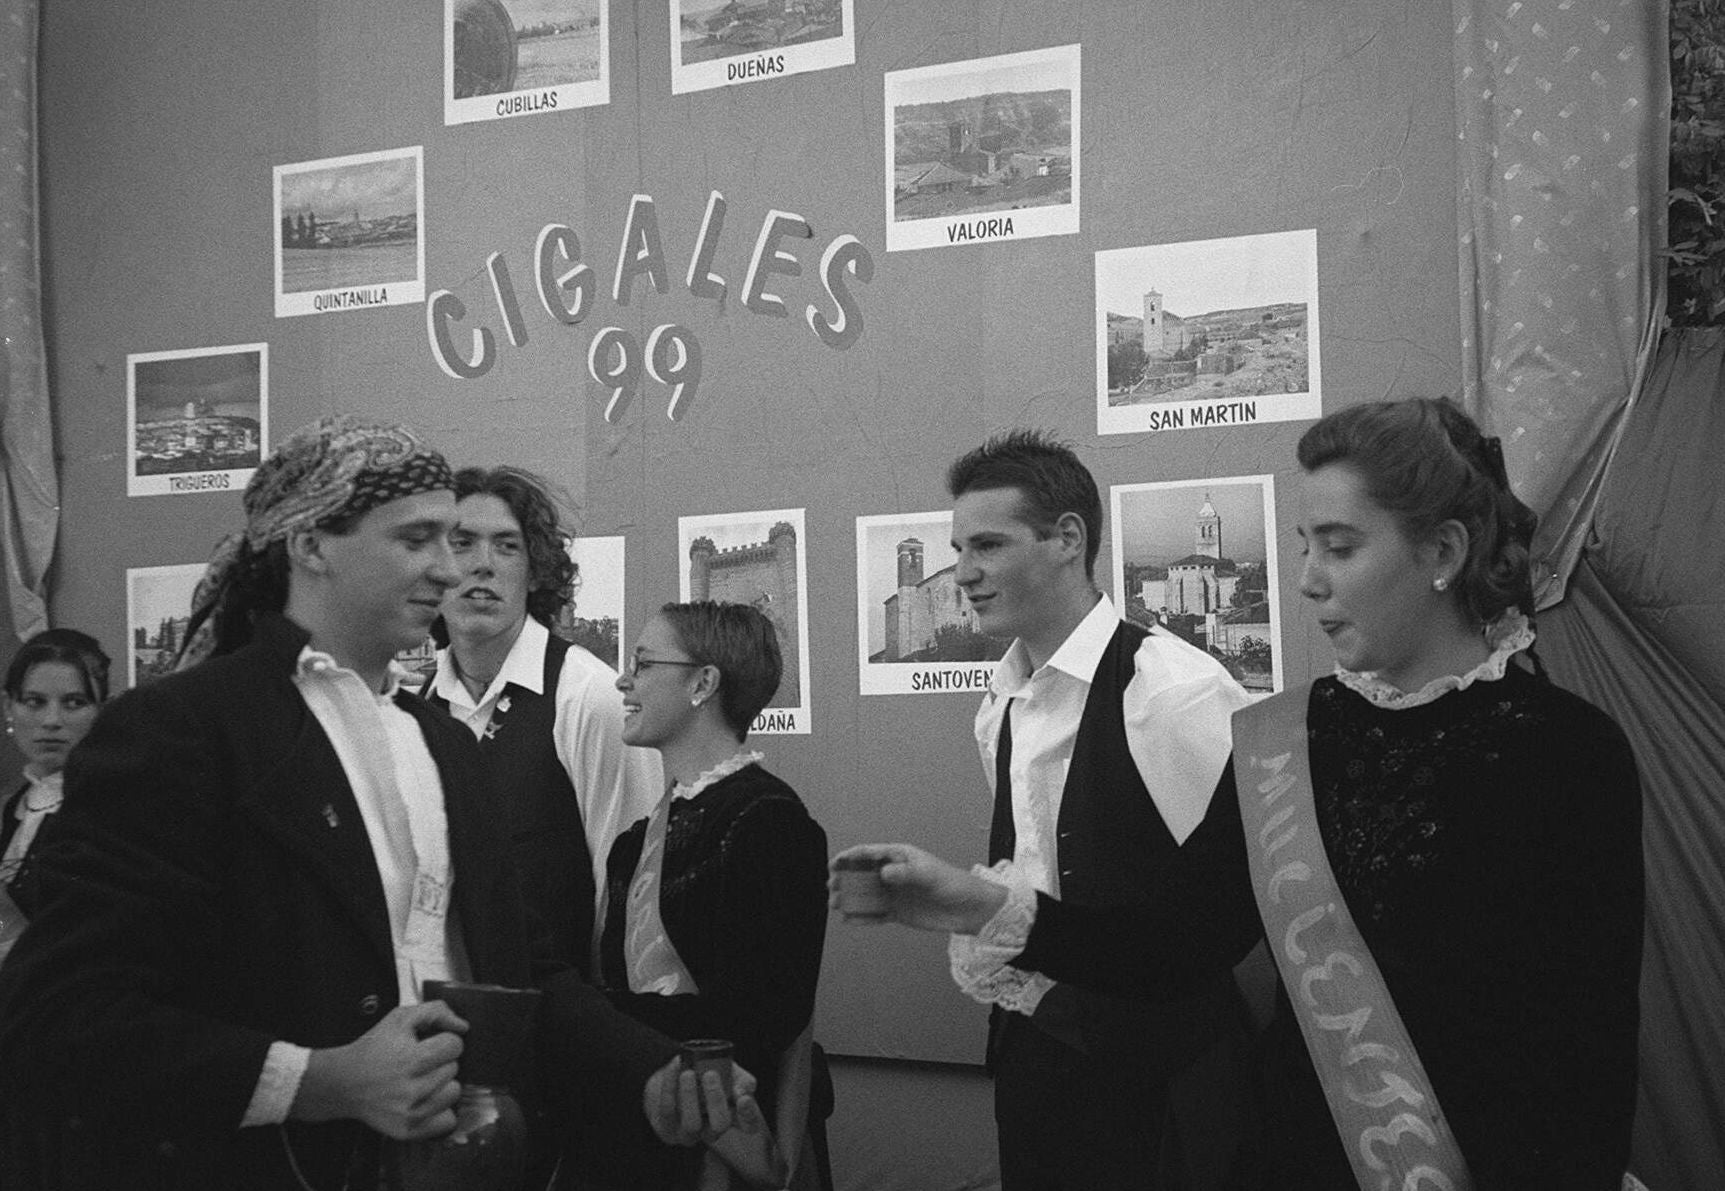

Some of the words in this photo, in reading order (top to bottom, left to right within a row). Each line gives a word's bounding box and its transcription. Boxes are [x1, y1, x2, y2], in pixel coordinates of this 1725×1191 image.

[727, 55, 784, 81] DUEÑAS
[496, 91, 558, 116] CUBILLAS
[947, 218, 1014, 242] VALORIA
[426, 190, 876, 380] CIGALES
[314, 288, 387, 312] QUINTANILLA
[588, 323, 701, 423] 99
[1150, 408, 1184, 431] SAN
[1191, 402, 1256, 427] MARTIN
[169, 473, 230, 493] TRIGUEROS
